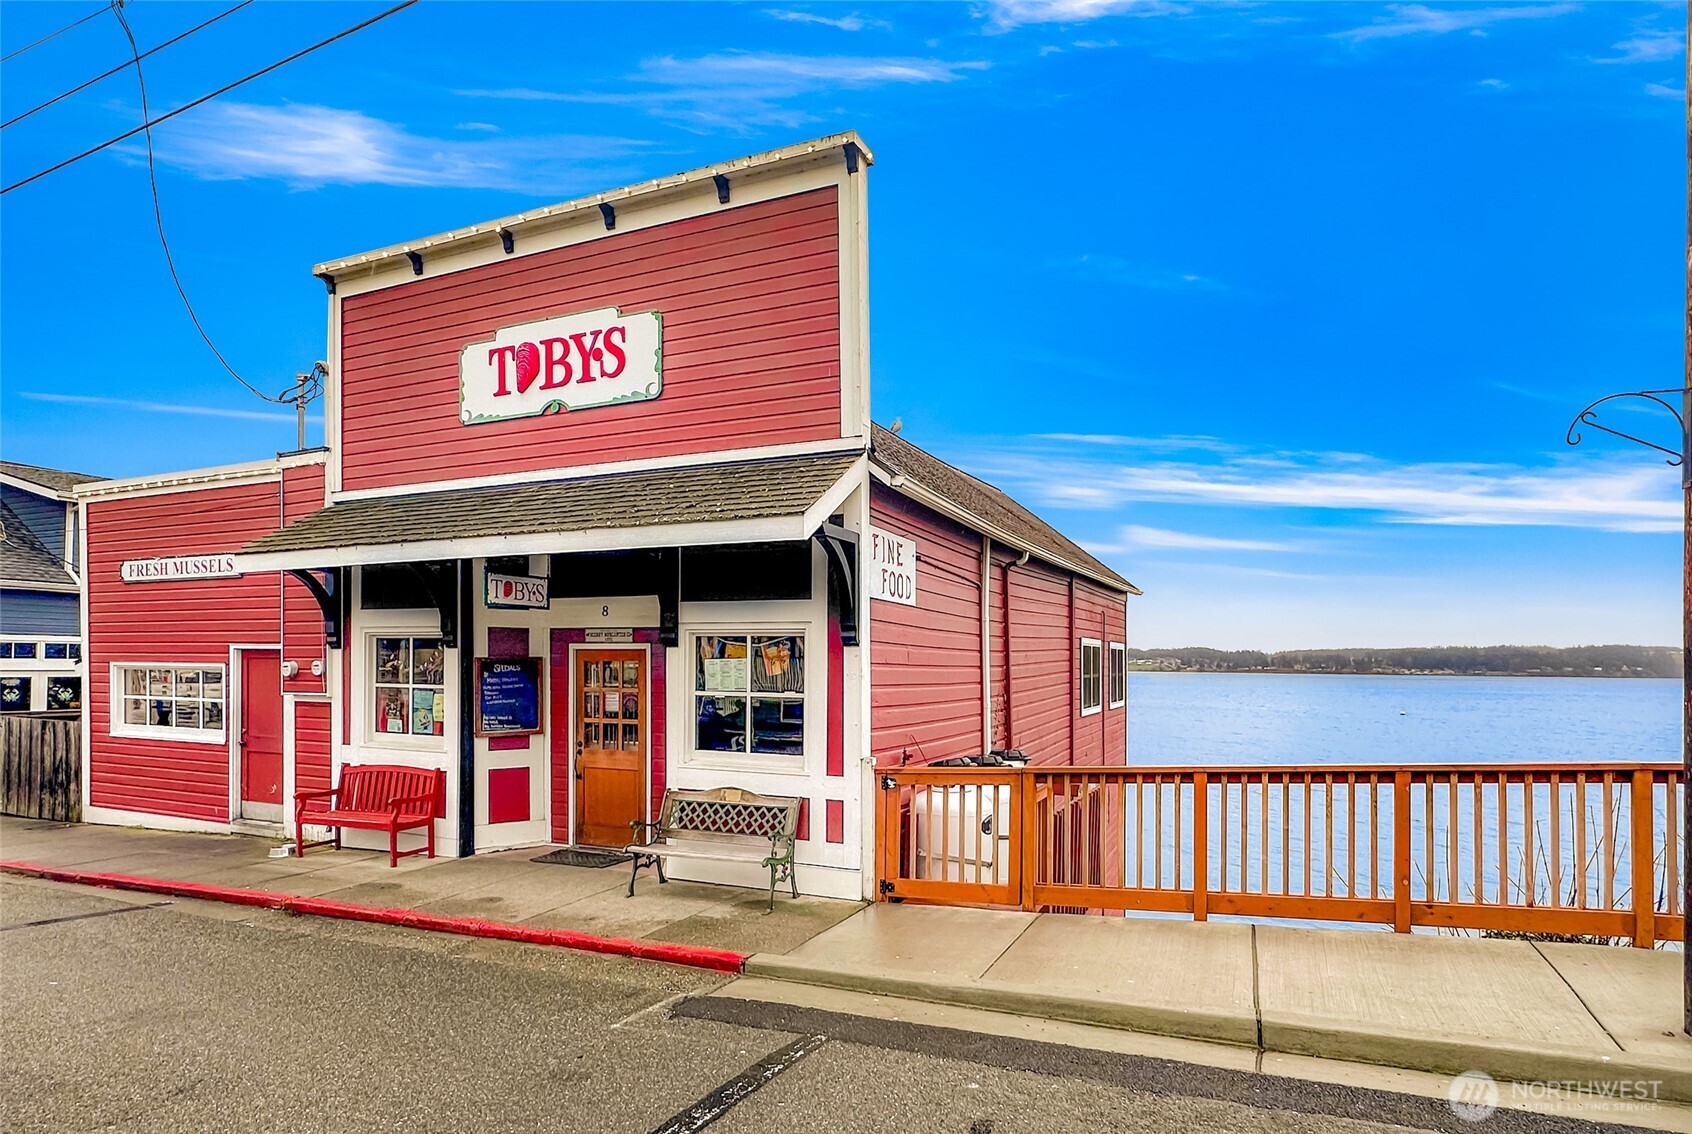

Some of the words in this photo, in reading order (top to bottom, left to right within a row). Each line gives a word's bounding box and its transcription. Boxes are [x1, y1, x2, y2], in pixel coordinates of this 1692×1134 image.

[871, 533, 904, 567] FINE
[128, 561, 168, 578] FRESH
[172, 557, 235, 576] MUSSELS
[881, 568, 912, 600] FOOD
[601, 605, 609, 617] 8
